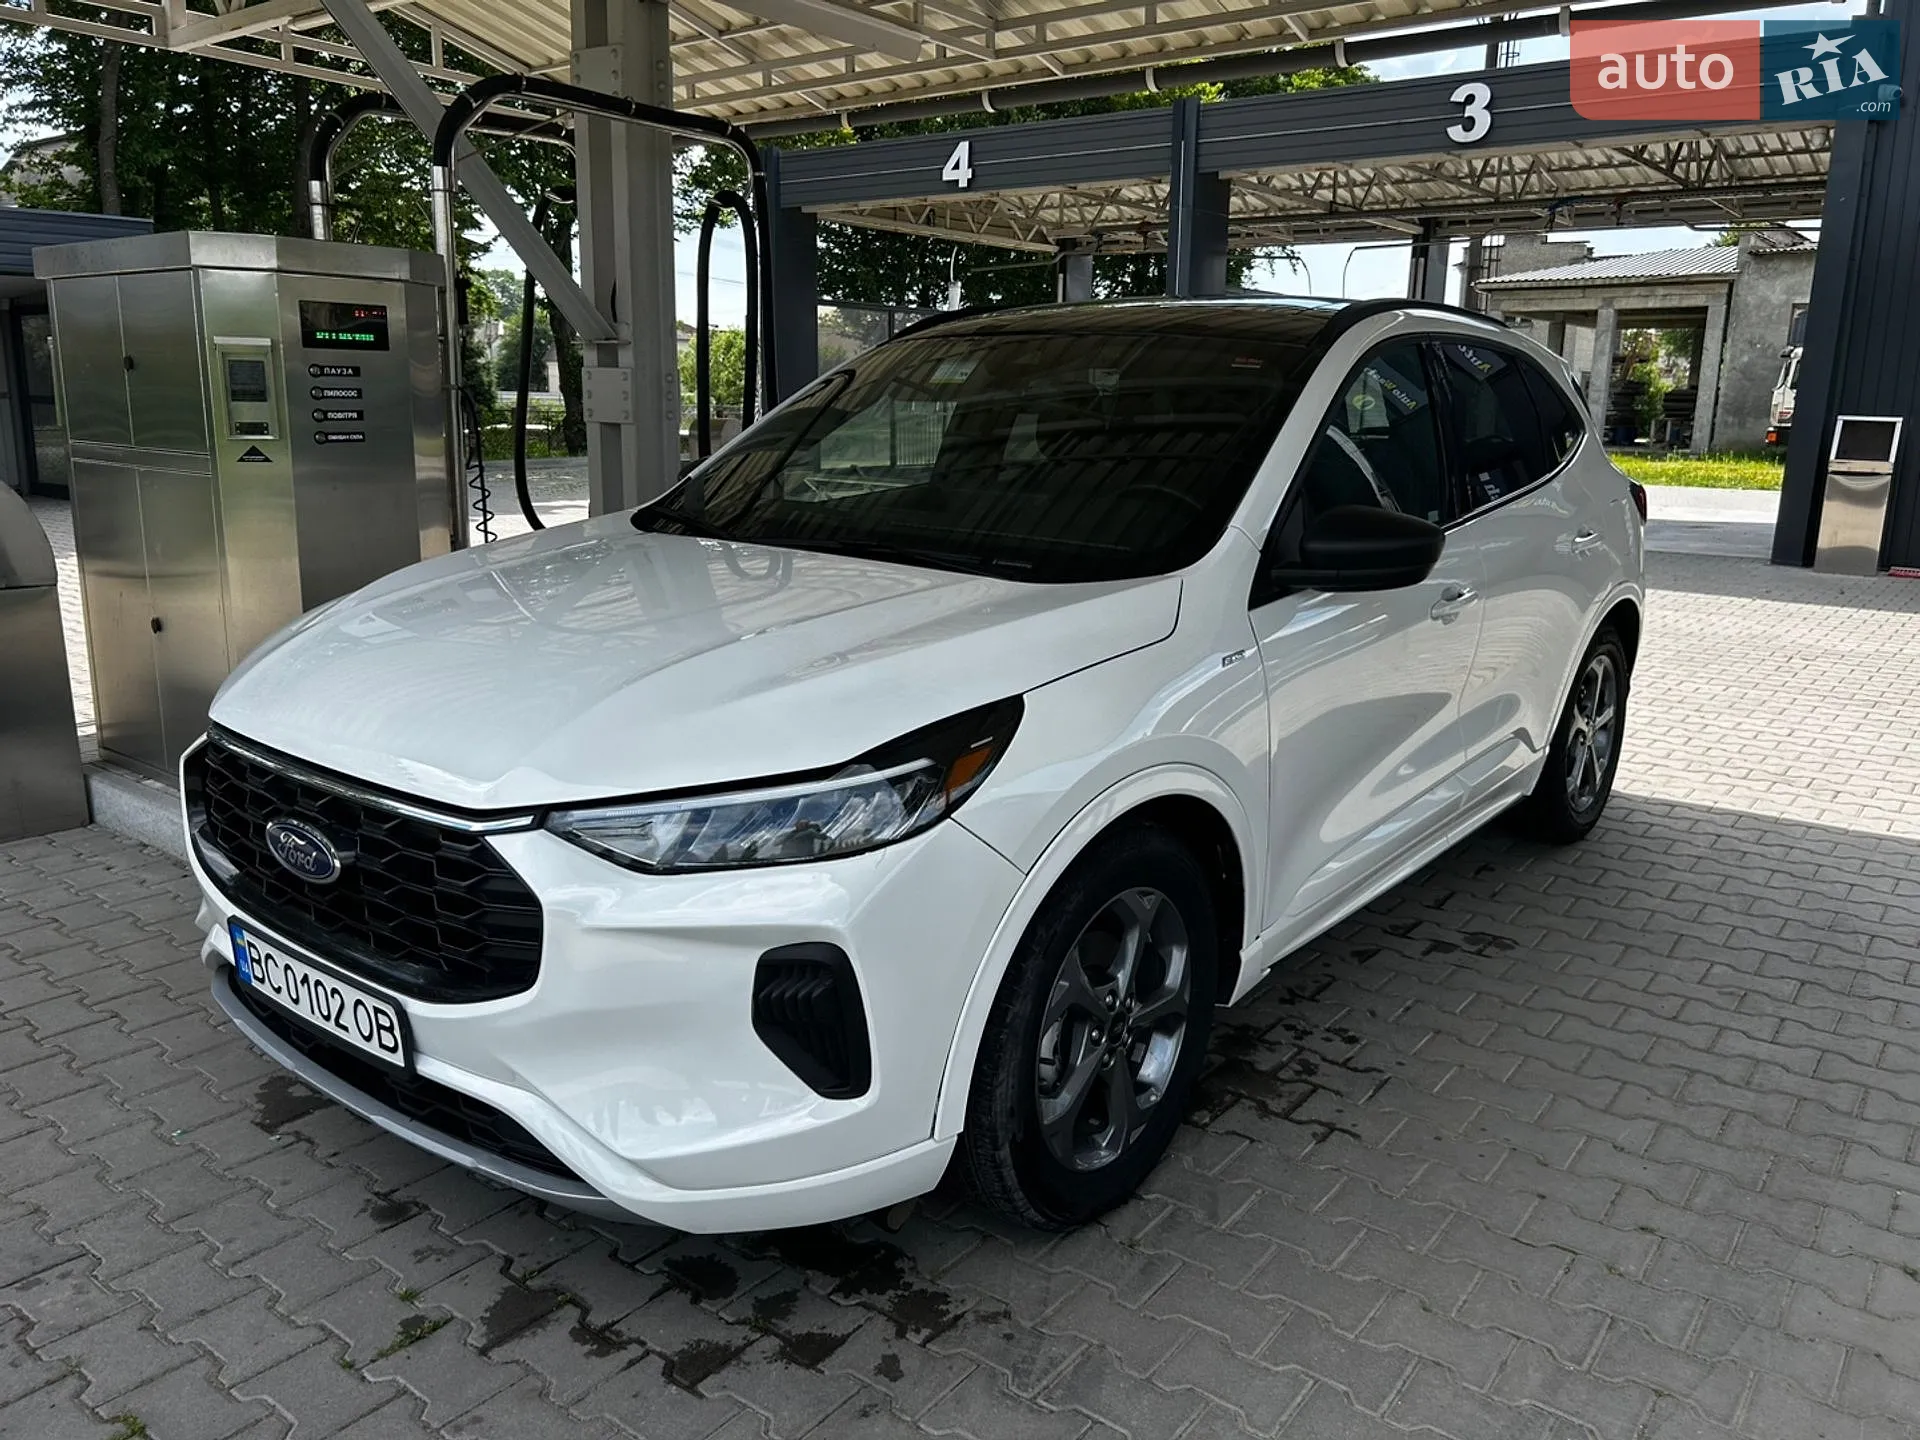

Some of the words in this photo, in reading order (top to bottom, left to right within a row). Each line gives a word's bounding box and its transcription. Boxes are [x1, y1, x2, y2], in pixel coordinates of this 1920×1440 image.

[1446, 83, 1491, 143] 3
[943, 141, 972, 188] 4
[323, 367, 354, 375] ПАУЗА
[323, 389, 358, 397] ПИЛОСОС
[277, 832, 317, 872] Ford
